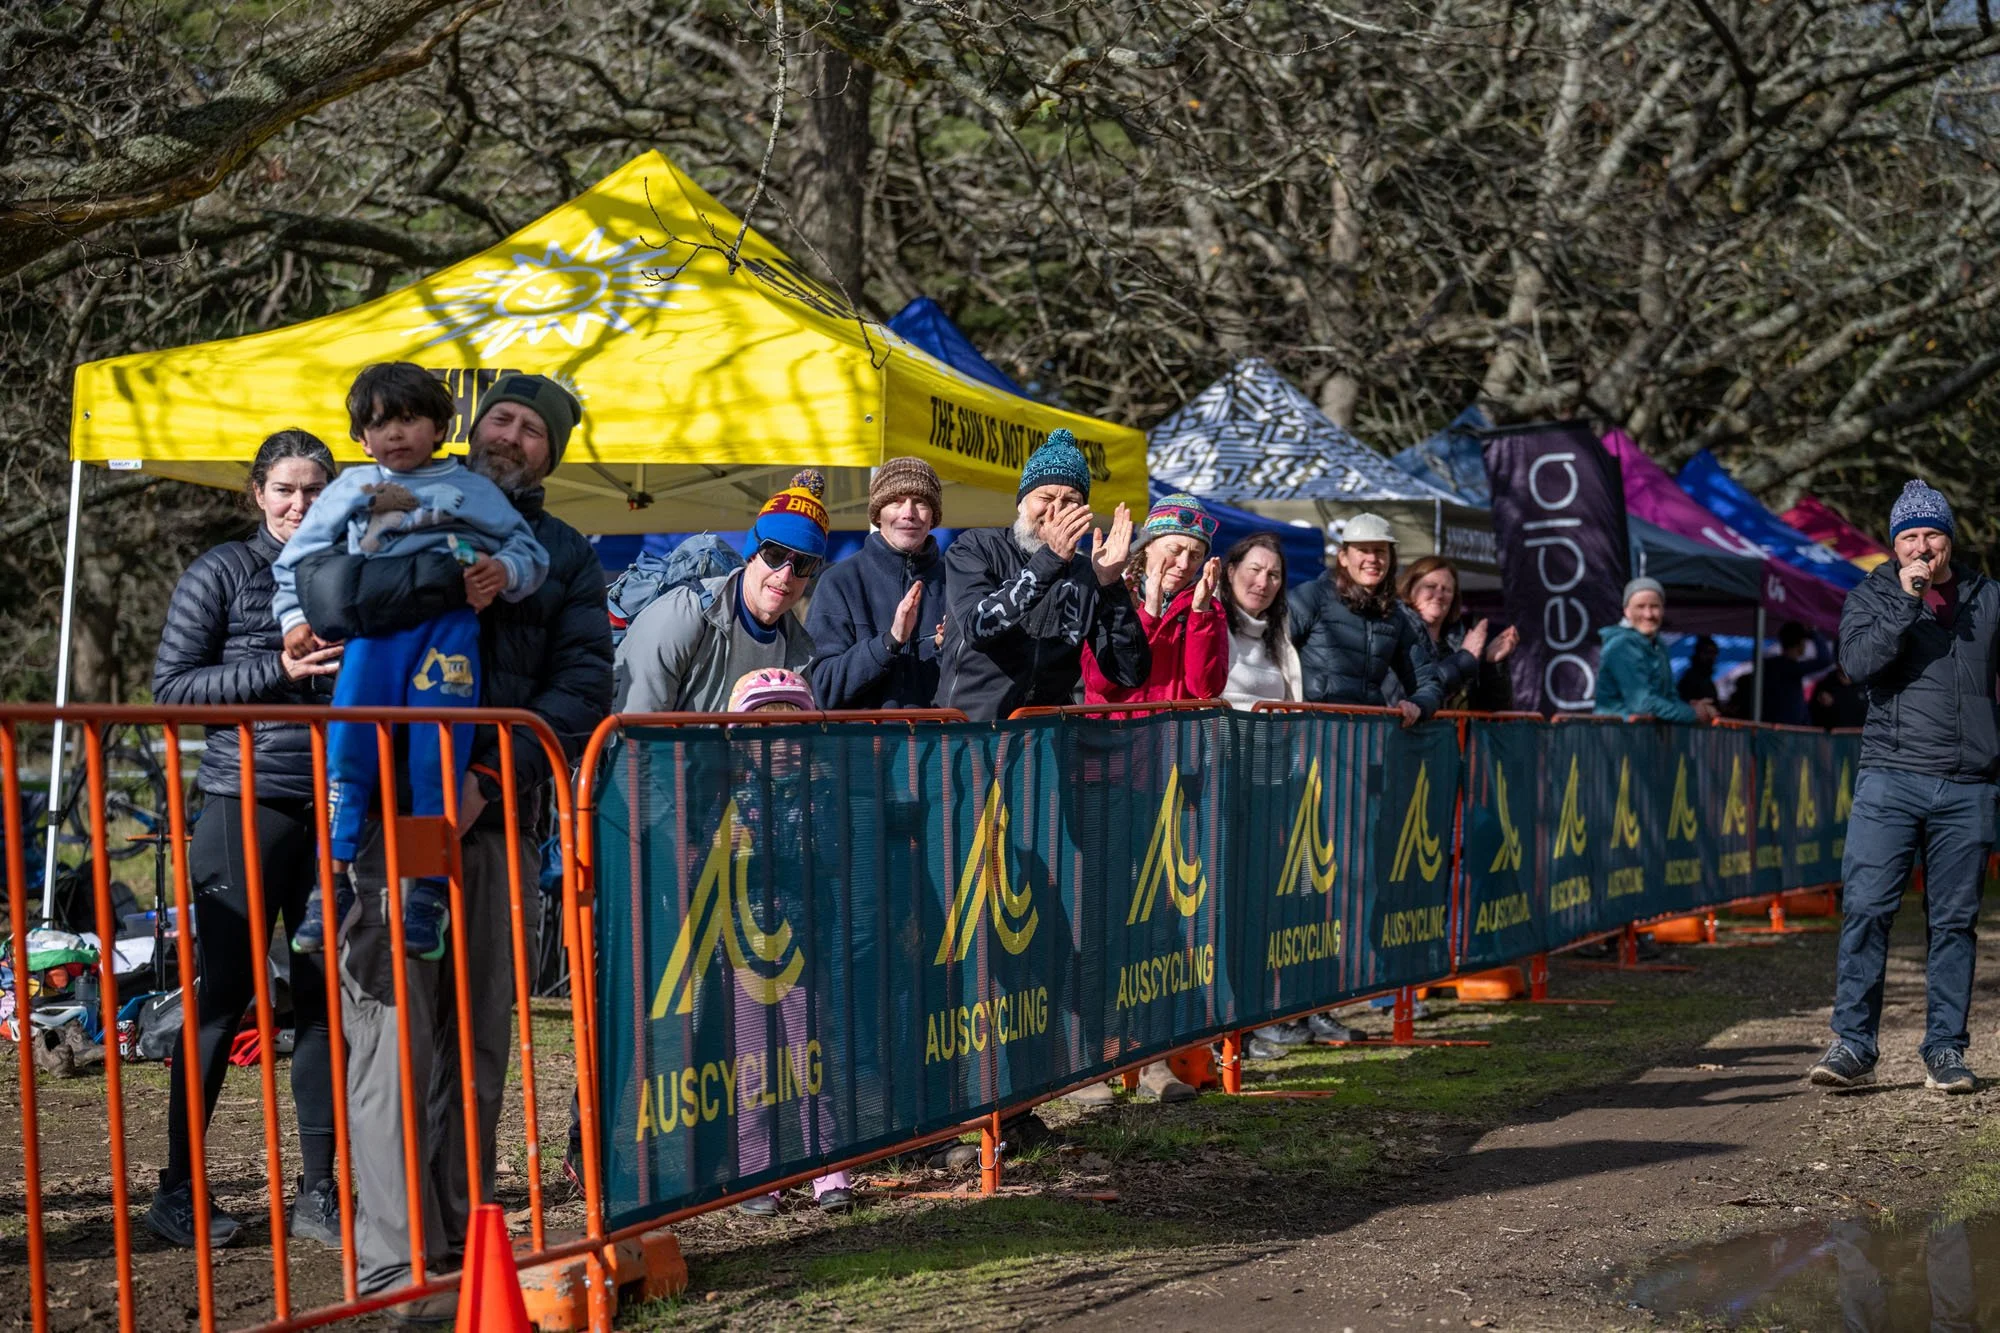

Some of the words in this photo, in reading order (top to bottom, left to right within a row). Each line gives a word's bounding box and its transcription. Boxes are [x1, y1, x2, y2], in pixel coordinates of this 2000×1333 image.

[929, 396, 955, 451] THE
[957, 405, 985, 460] SUN
[985, 415, 1000, 464] IS
[1000, 420, 1025, 470] NOT
[1522, 453, 1596, 710] pedla
[1116, 943, 1214, 1011] AUSCYCLING
[1267, 919, 1342, 971] AUSCYCLING
[925, 986, 1048, 1066] AUSCYCLING
[636, 1039, 823, 1143] AUSCYCLING
